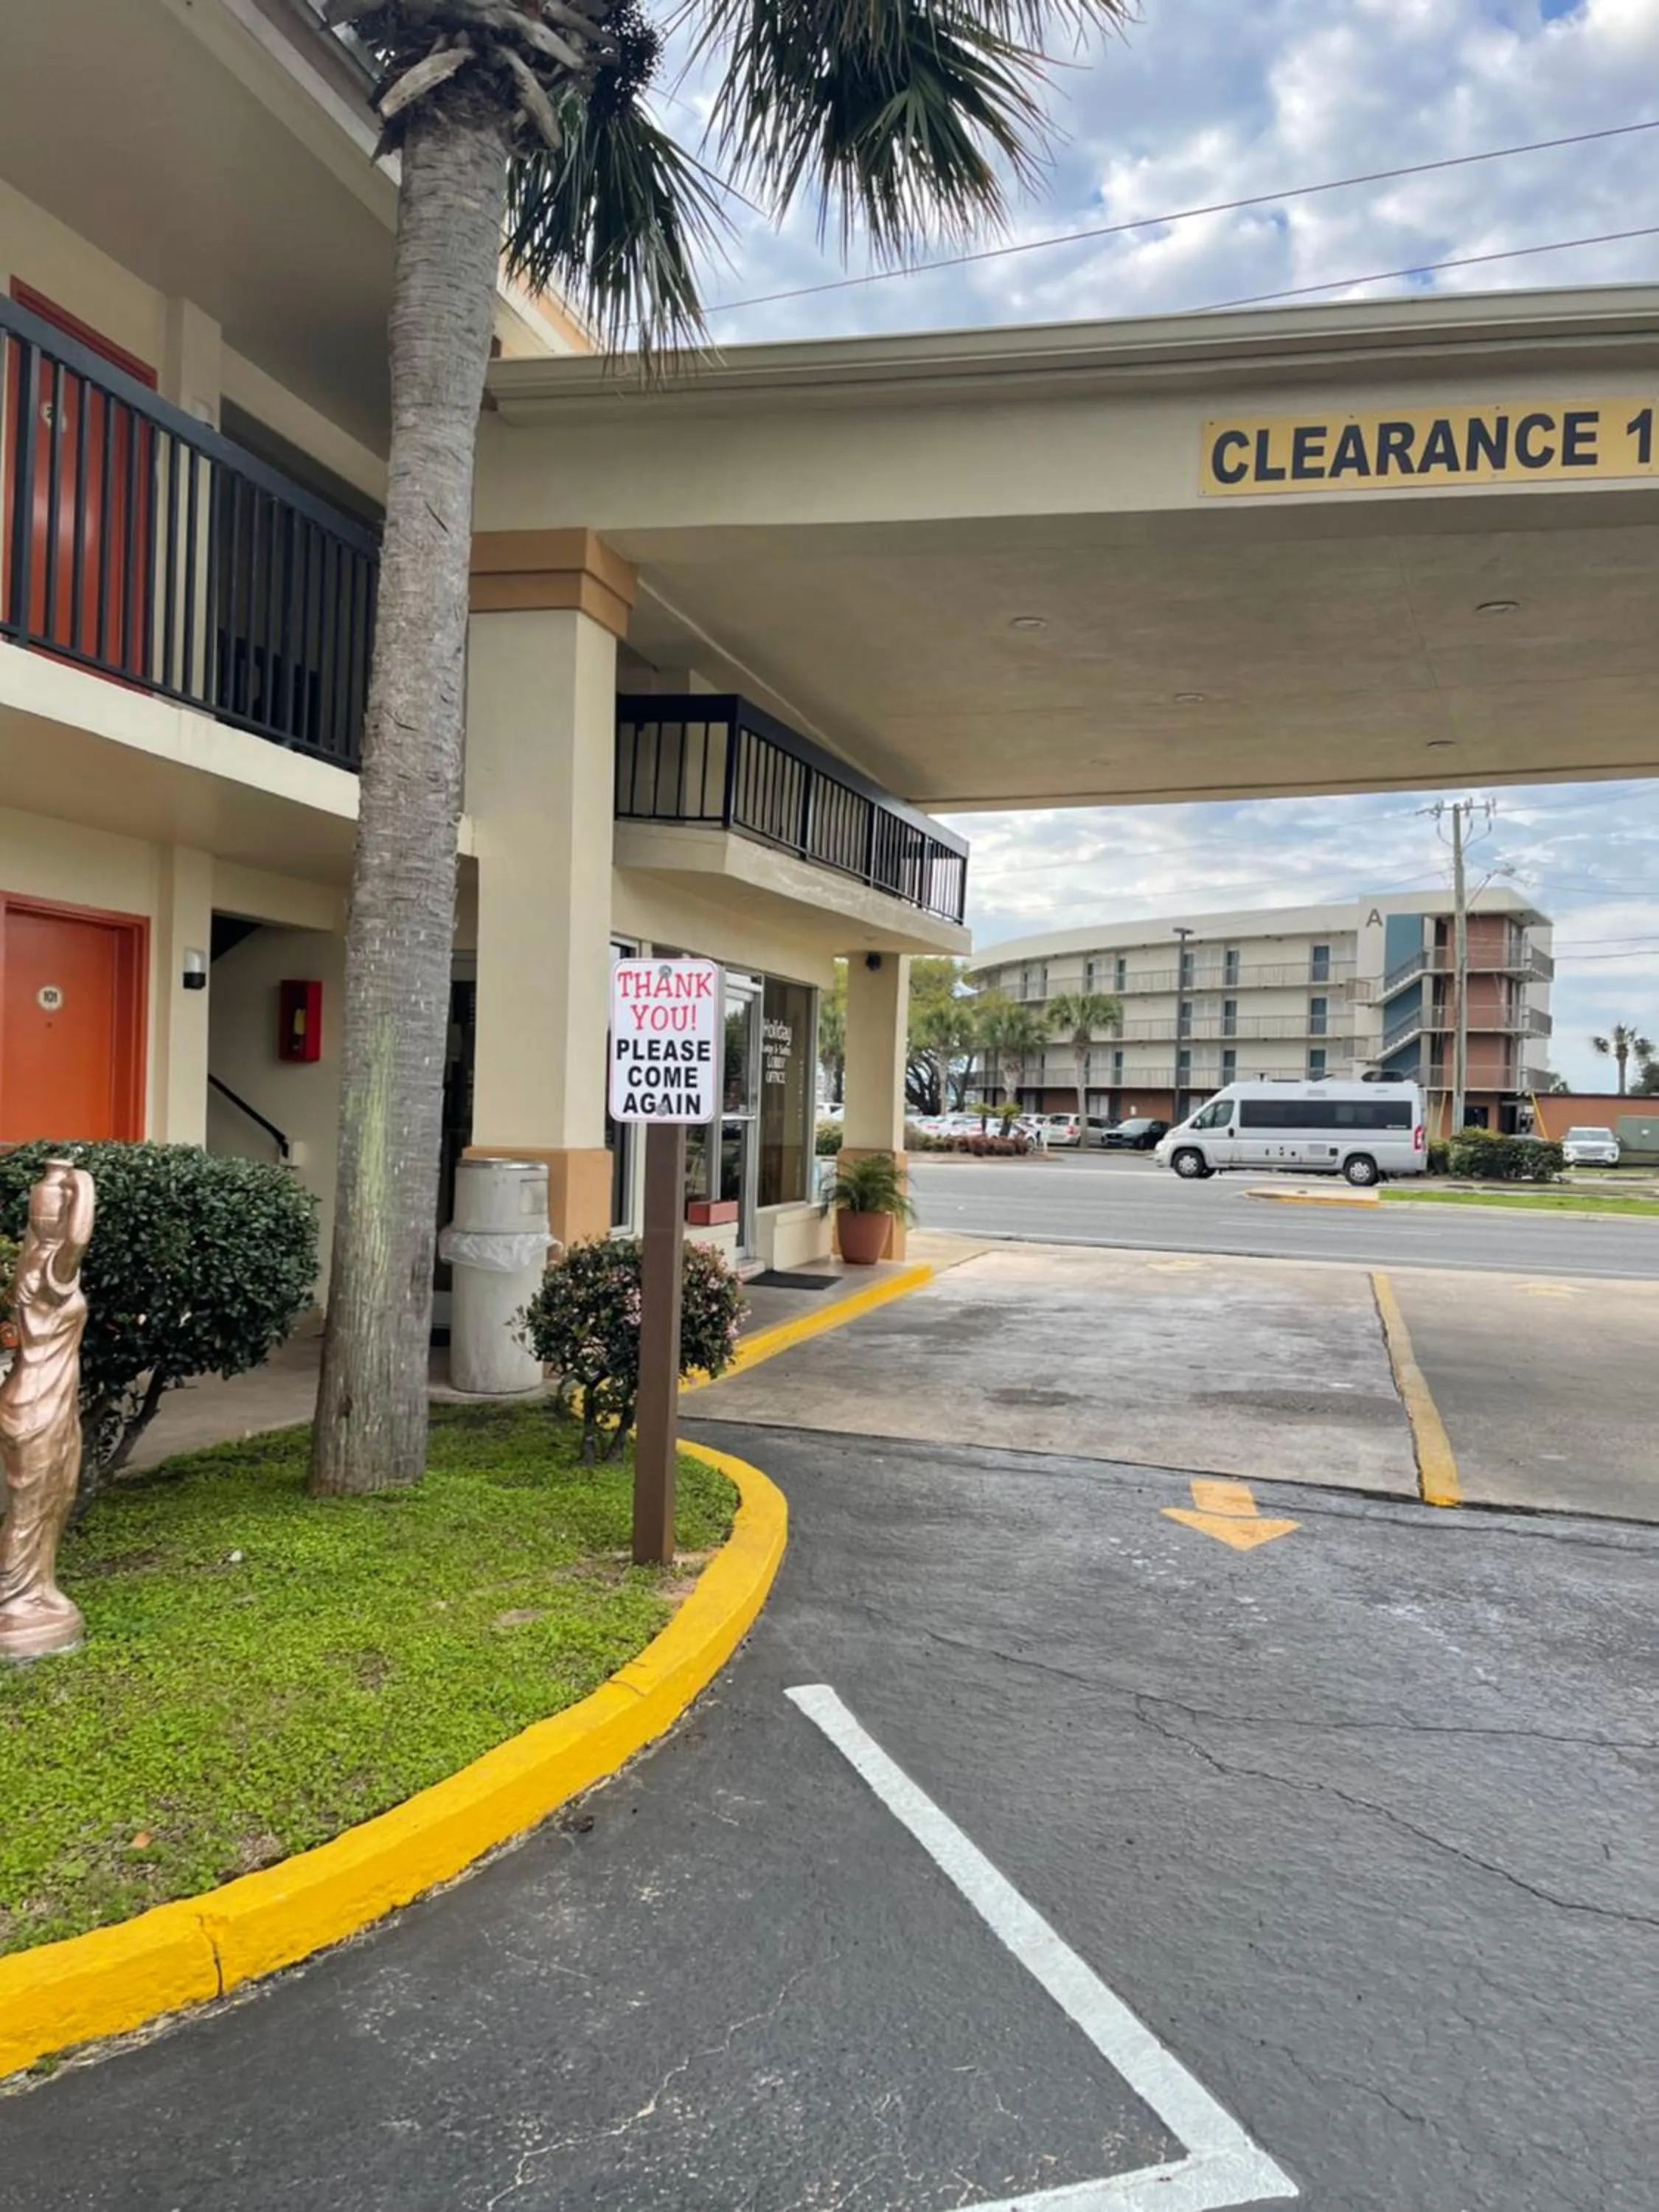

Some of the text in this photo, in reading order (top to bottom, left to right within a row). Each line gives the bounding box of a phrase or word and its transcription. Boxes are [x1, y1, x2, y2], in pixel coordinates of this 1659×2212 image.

[1211, 410, 1599, 484] CLEARANCE
[1366, 908, 1383, 928] A
[616, 970, 712, 998] THANK
[44, 990, 58, 1004] 101
[630, 1004, 697, 1032] YOU!
[616, 1038, 711, 1062] PLEASE
[627, 1065, 698, 1088] COME
[623, 1092, 700, 1115] AGAIN
